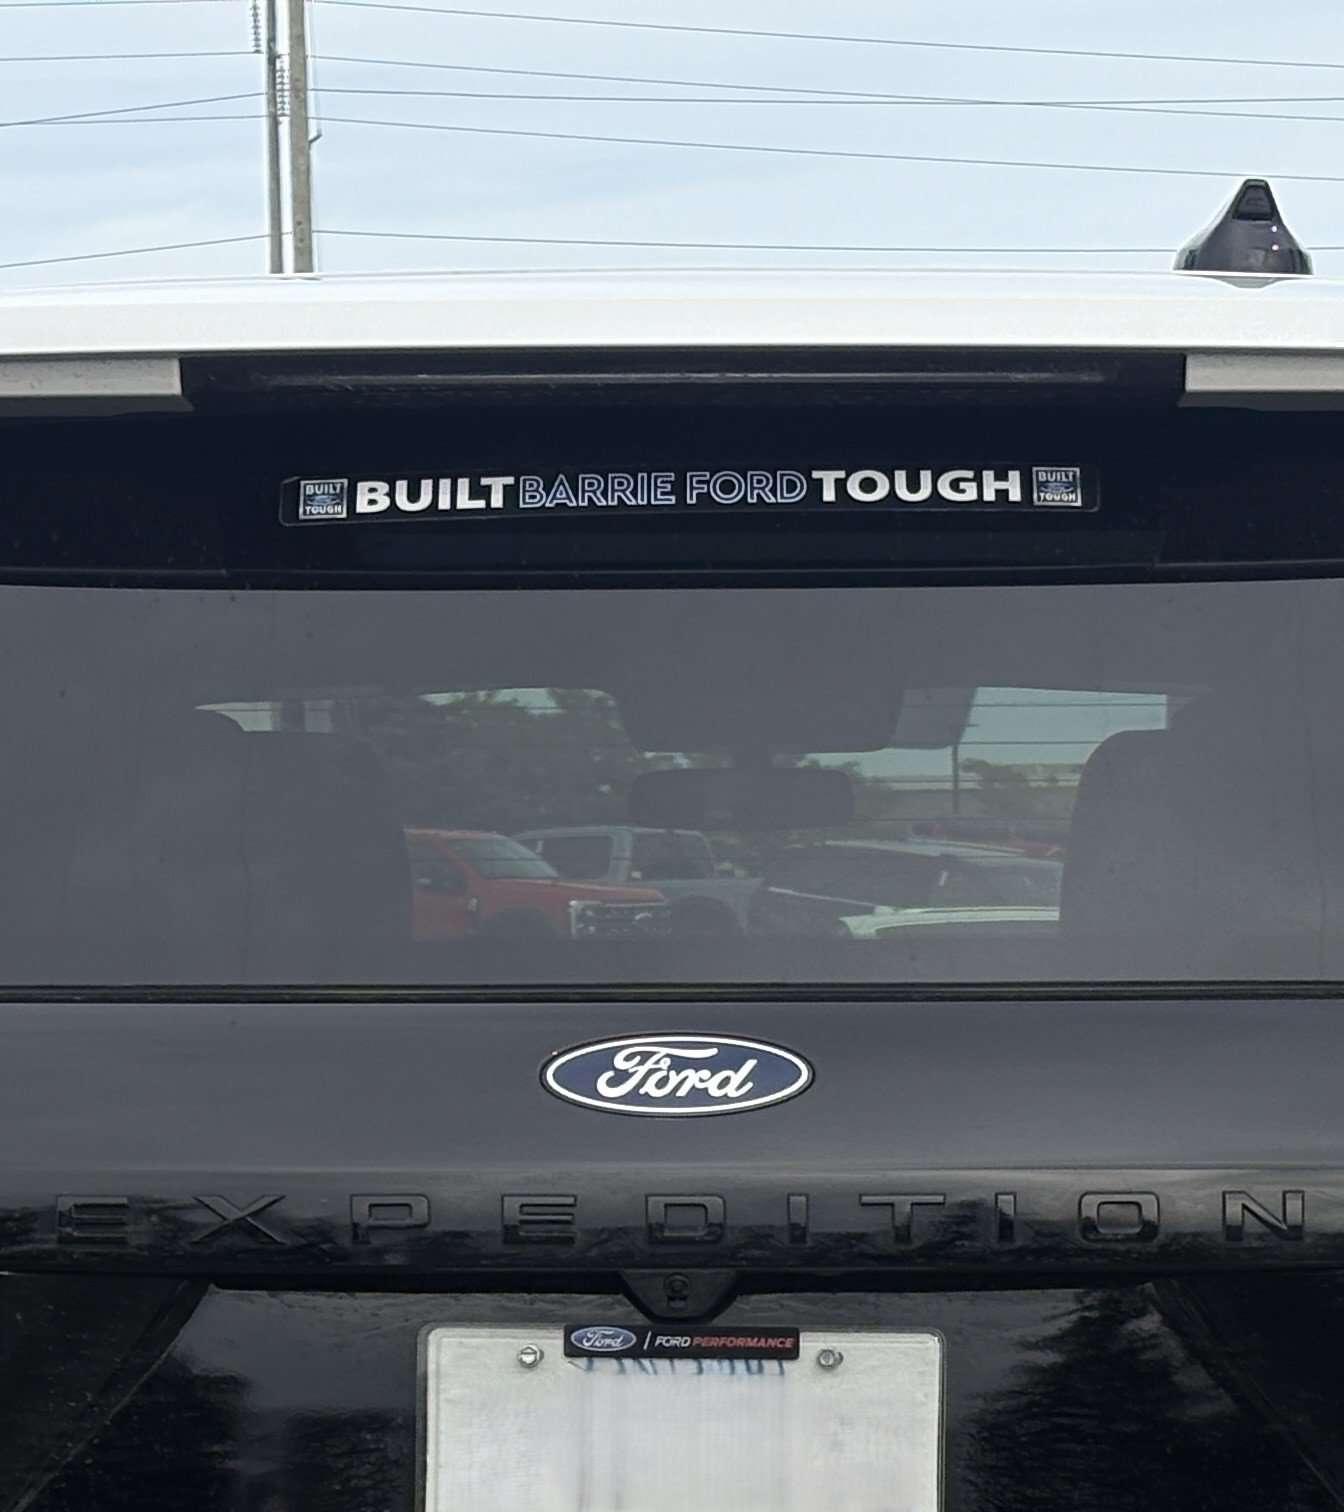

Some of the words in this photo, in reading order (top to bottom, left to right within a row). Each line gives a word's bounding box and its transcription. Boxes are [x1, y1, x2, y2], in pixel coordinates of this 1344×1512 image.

[1038, 471, 1074, 482] BUILT
[305, 483, 342, 495] BUILT
[356, 476, 515, 513] BUILT
[519, 472, 676, 508] BARRIE
[686, 470, 807, 504] FORD
[811, 469, 1022, 502] TOUGH
[1039, 492, 1076, 502] TOUGH
[305, 504, 342, 515] TOUGH
[596, 1046, 758, 1098] Ford
[55, 1191, 1306, 1245] EXPEDITION
[582, 1330, 624, 1347] Ford
[655, 1335, 692, 1348] FORD
[692, 1336, 795, 1349] PERFORMANCE
